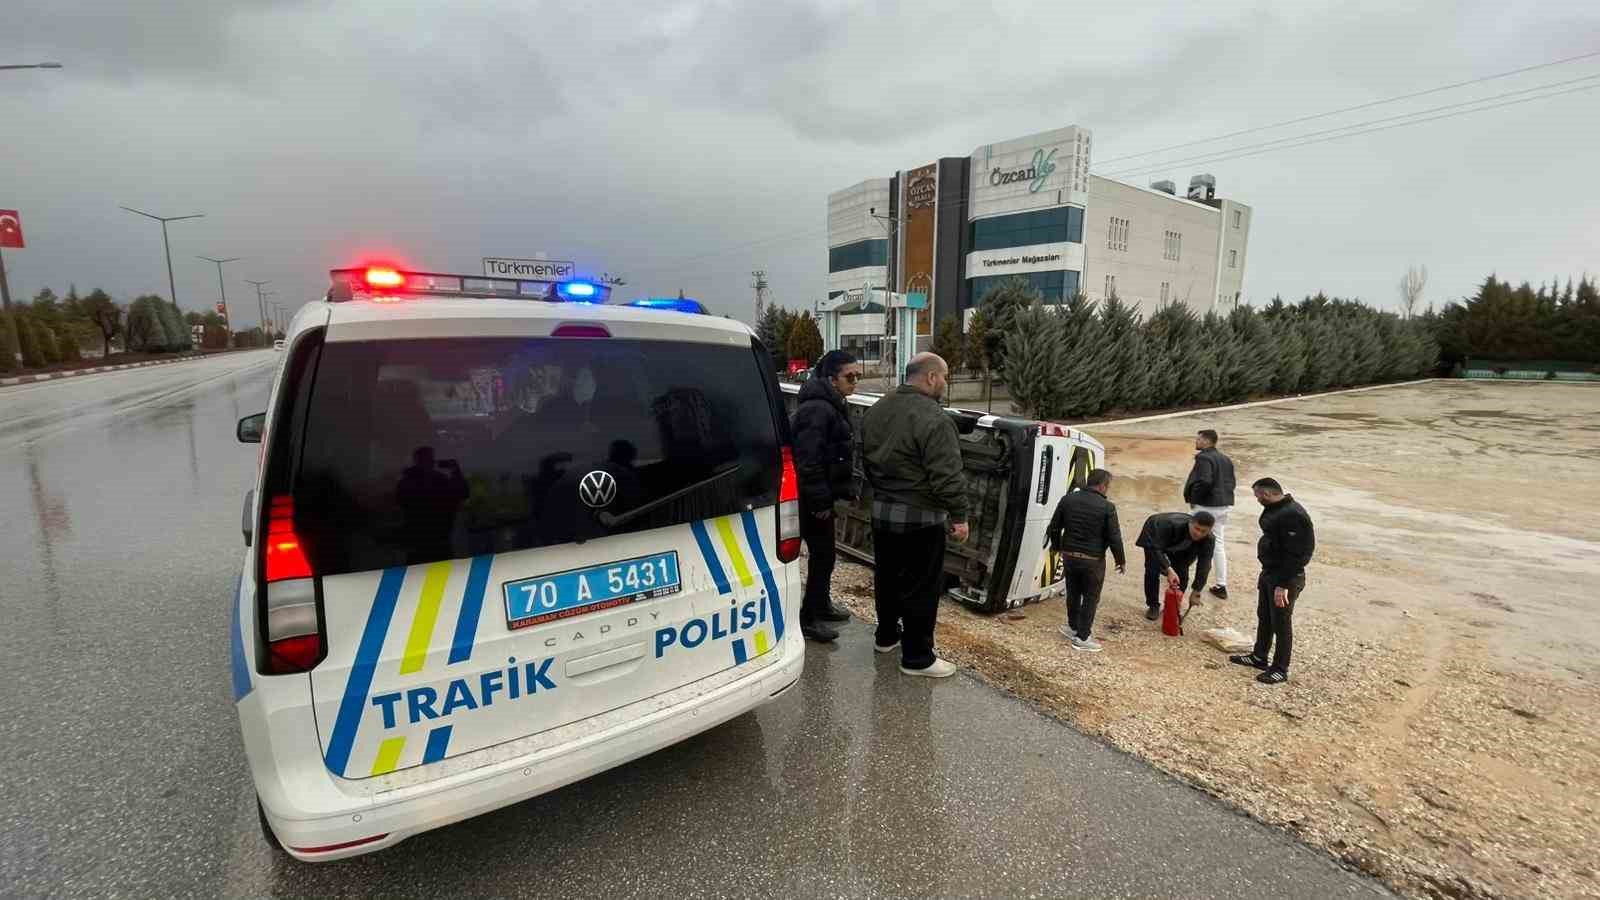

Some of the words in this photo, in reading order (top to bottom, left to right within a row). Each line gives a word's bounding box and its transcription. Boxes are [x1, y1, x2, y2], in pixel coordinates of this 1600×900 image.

[990, 167, 1036, 186] Özcan
[487, 260, 571, 277] Türkmenler
[521, 581, 558, 613] 70
[577, 574, 593, 601] A
[607, 557, 669, 594] 5431
[544, 610, 661, 647] CADDY
[655, 589, 768, 659] POLİSİ
[372, 656, 558, 729] TRAFİK
